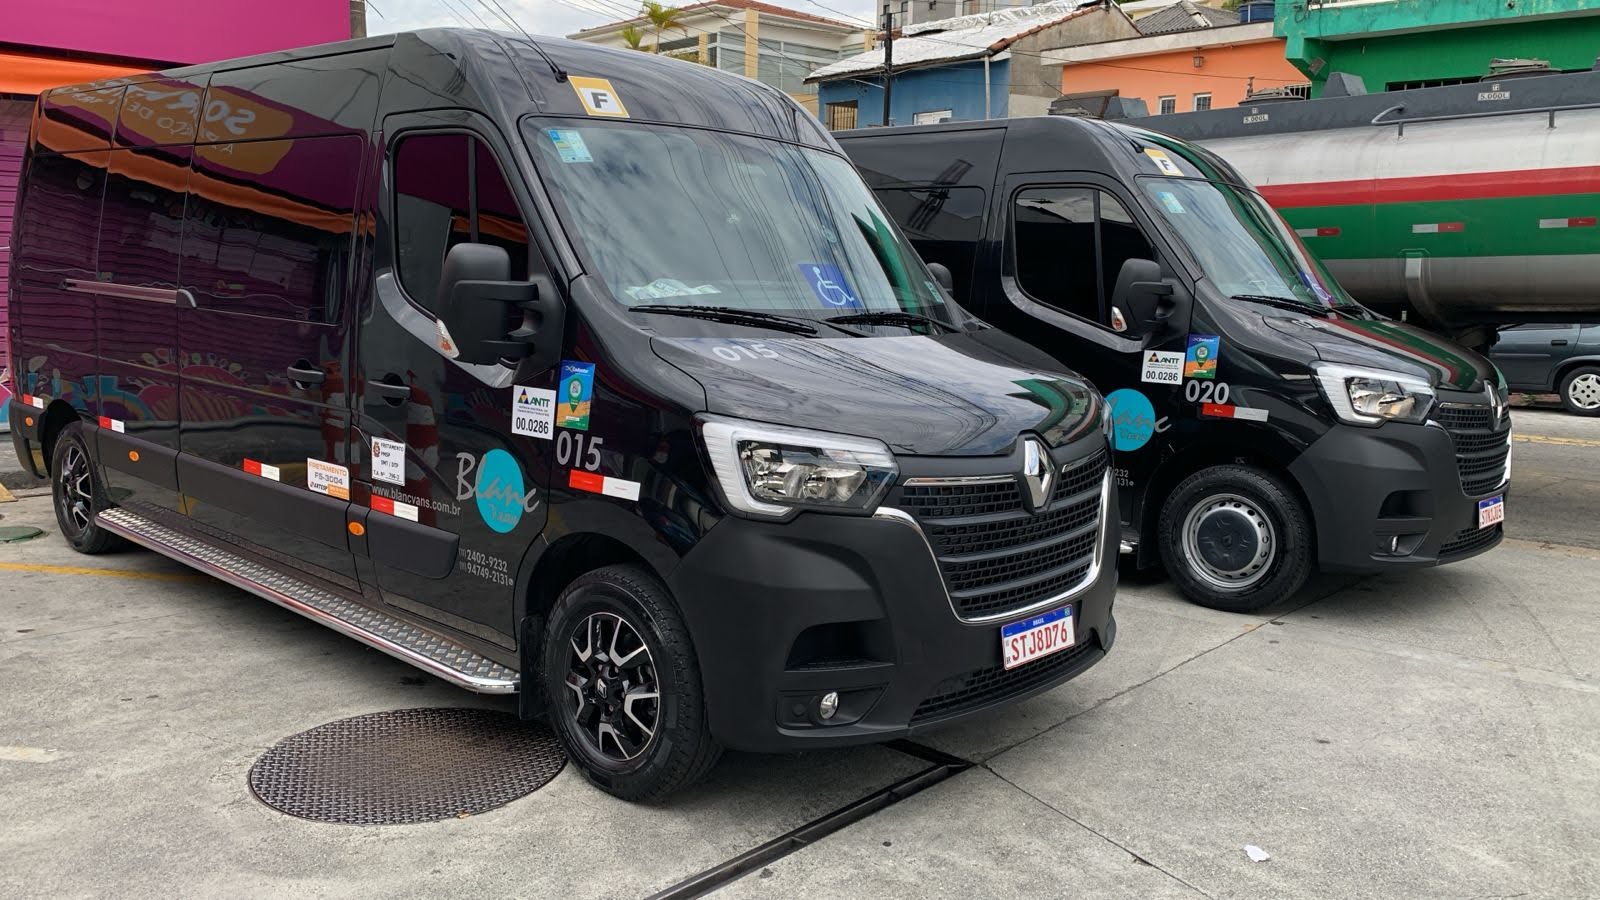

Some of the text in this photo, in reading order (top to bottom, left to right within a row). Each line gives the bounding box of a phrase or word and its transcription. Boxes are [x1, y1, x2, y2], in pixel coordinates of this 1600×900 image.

[591, 92, 608, 109] F
[1160, 160, 1170, 170] F
[712, 344, 779, 361] 015
[1146, 371, 1178, 382] 00.0286
[530, 396, 551, 408] ANTT
[1185, 380, 1230, 405] 020
[516, 416, 549, 435] 00.0286
[556, 430, 604, 471] 015
[456, 452, 540, 513] Blanc
[372, 485, 461, 516] www.blancvans.com.br
[467, 549, 508, 573] 2402-9232
[1011, 620, 1068, 662] STJ8D76
